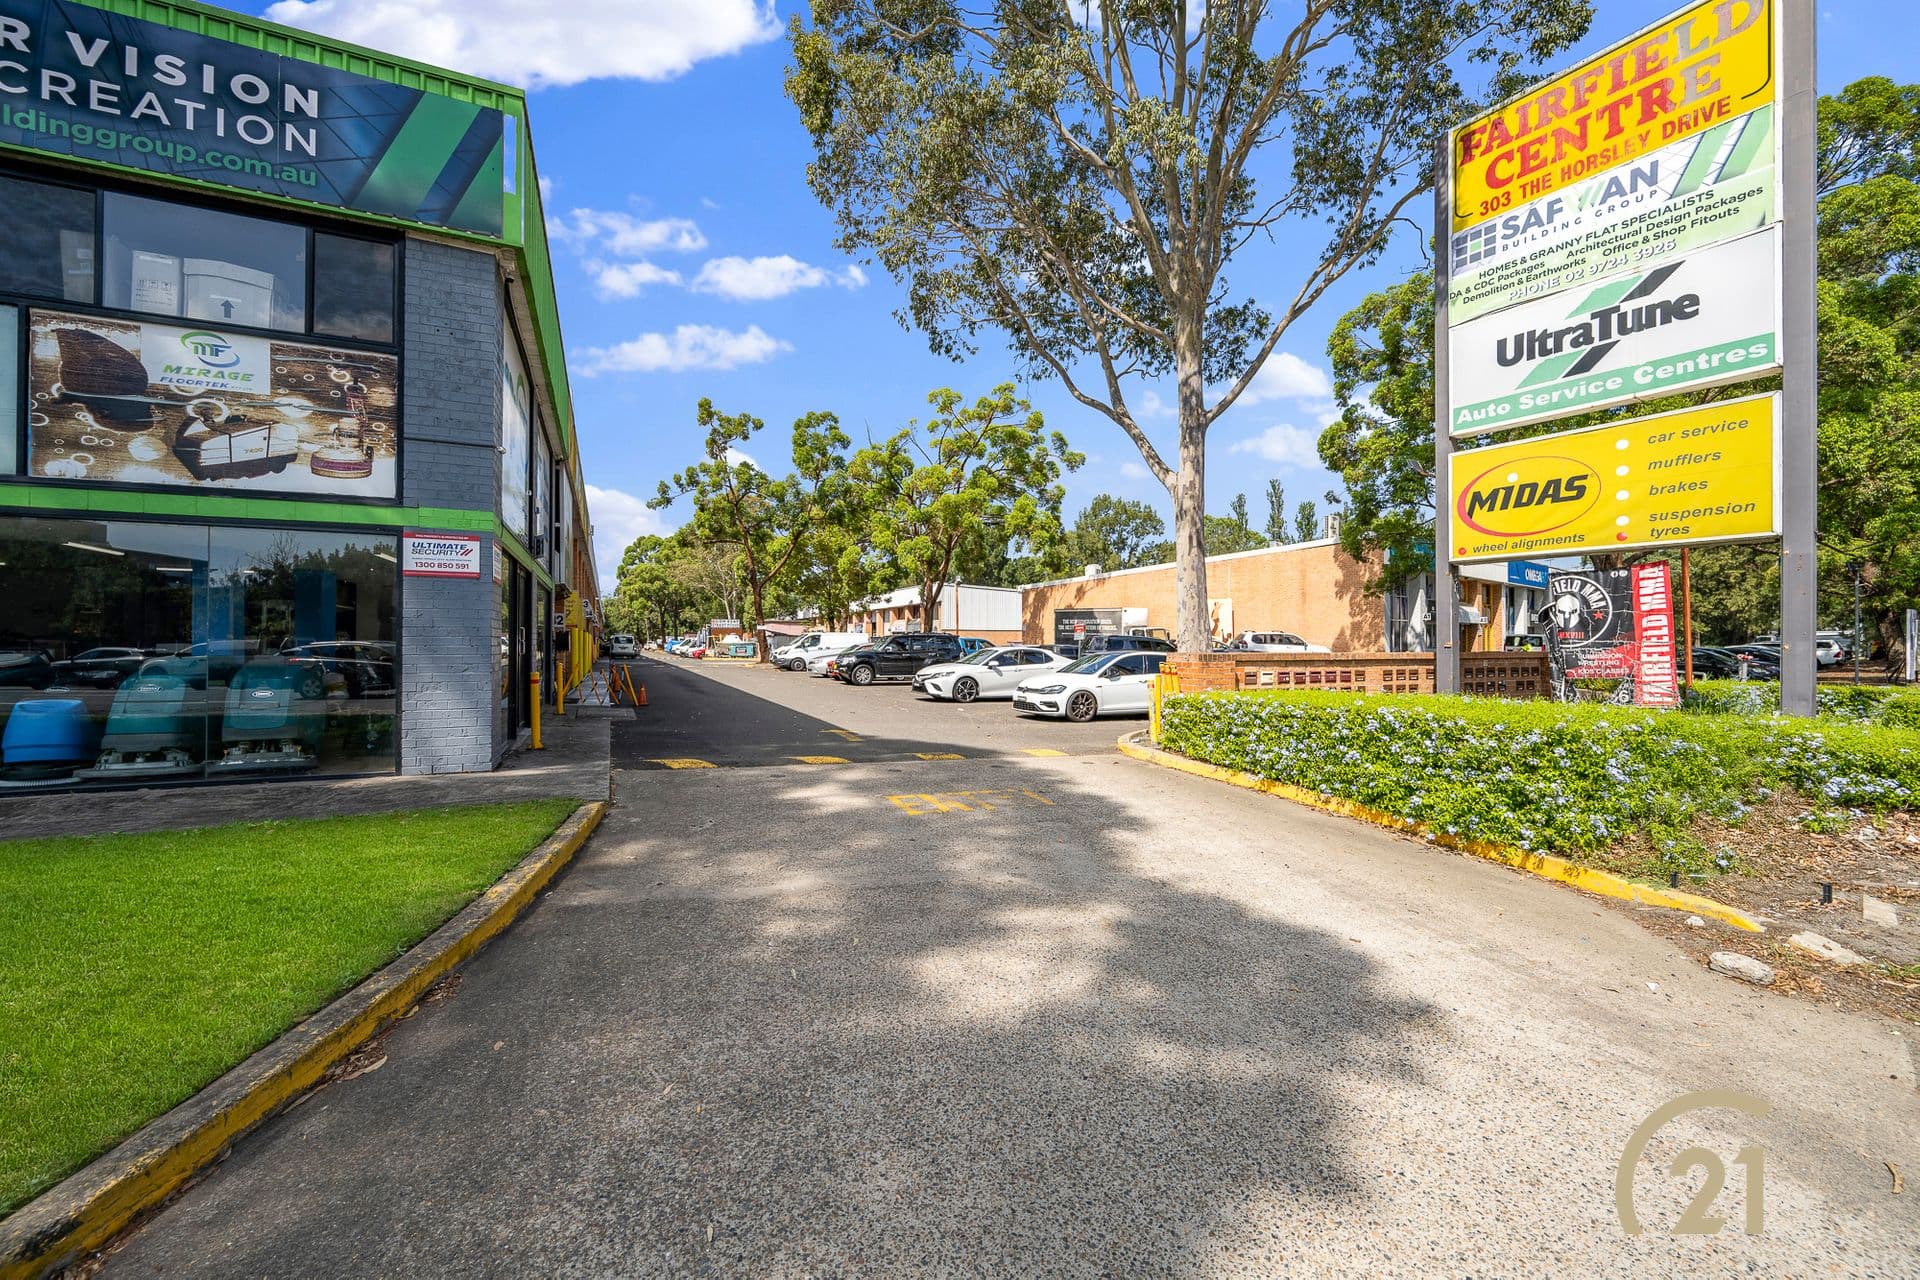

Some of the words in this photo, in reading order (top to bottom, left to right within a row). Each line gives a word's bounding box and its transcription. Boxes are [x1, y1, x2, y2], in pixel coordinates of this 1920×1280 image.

[65, 31, 319, 118] VISION
[1460, 0, 1764, 167] FAIRFIELD
[0, 60, 317, 157] CREATION
[1485, 52, 1721, 190] CENTRE
[2, 103, 317, 187] ldinggroup.com.au
[1479, 191, 1511, 217] 303
[1519, 172, 1553, 200] THE
[1560, 129, 1651, 183] HORSLEY
[1662, 96, 1731, 140] DRIVE
[1478, 258, 1518, 280] HOMES
[1519, 256, 1528, 266] &
[1529, 235, 1583, 261] GRANNY
[1585, 223, 1618, 243] FLAT
[1621, 189, 1715, 229] SPECIALISTS
[1502, 216, 1582, 252] BUILDING
[1594, 189, 1658, 218] GROUP
[1566, 225, 1642, 259] Architectural
[1646, 211, 1691, 233] Design
[1695, 186, 1764, 215] Packages
[1602, 239, 1639, 257] Office
[1641, 234, 1650, 244] &
[1653, 224, 1686, 243] Shop
[1691, 206, 1740, 230] Fitouts
[1449, 290, 1463, 300] DA
[1464, 286, 1472, 295] &
[1473, 277, 1495, 291] CDC
[1497, 261, 1546, 285] Packages
[1462, 281, 1515, 304] Demolition
[1516, 276, 1525, 286] &
[1526, 257, 1587, 283] Earthworks
[1509, 276, 1561, 301] PHONE
[1565, 268, 1585, 284] 02
[160, 376, 229, 389] FLOORTEK
[163, 364, 255, 382] MIRAGE
[1456, 402, 1511, 425] Auto
[1519, 376, 1623, 410] Service
[1633, 343, 1768, 385] Centres
[1648, 431, 1675, 445] car
[1680, 419, 1749, 439] service
[1648, 451, 1722, 470] mufflers
[1649, 480, 1708, 496] brakes
[1649, 502, 1756, 521] suspension
[411, 548, 462, 556] SECURITY
[412, 541, 468, 550] ULTIMATE
[1473, 541, 1509, 554] wheel
[1511, 533, 1585, 550] alignments
[1650, 525, 1690, 539] tyres
[1638, 565, 1667, 612] MMA
[1640, 614, 1676, 704] FAIRFIELD
